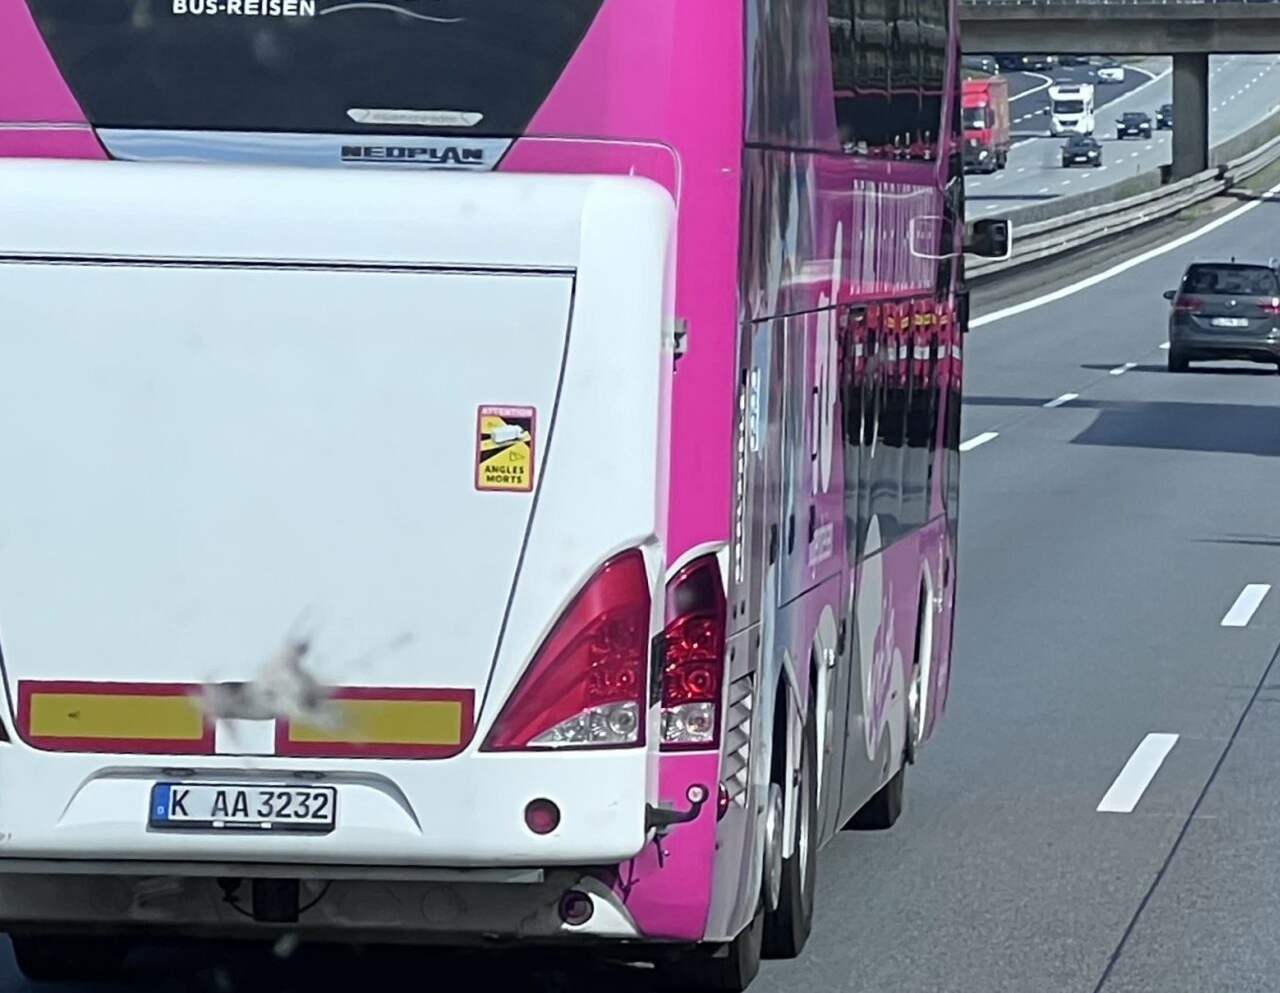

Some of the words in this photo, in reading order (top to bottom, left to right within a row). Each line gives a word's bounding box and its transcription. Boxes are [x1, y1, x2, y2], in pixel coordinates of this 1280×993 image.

[341, 145, 484, 165] NEOPLAN
[485, 465, 524, 474] ANGLES
[486, 475, 522, 484] MORTS
[171, 789, 191, 817] K
[210, 790, 250, 818] AA
[256, 791, 329, 820] 3232
